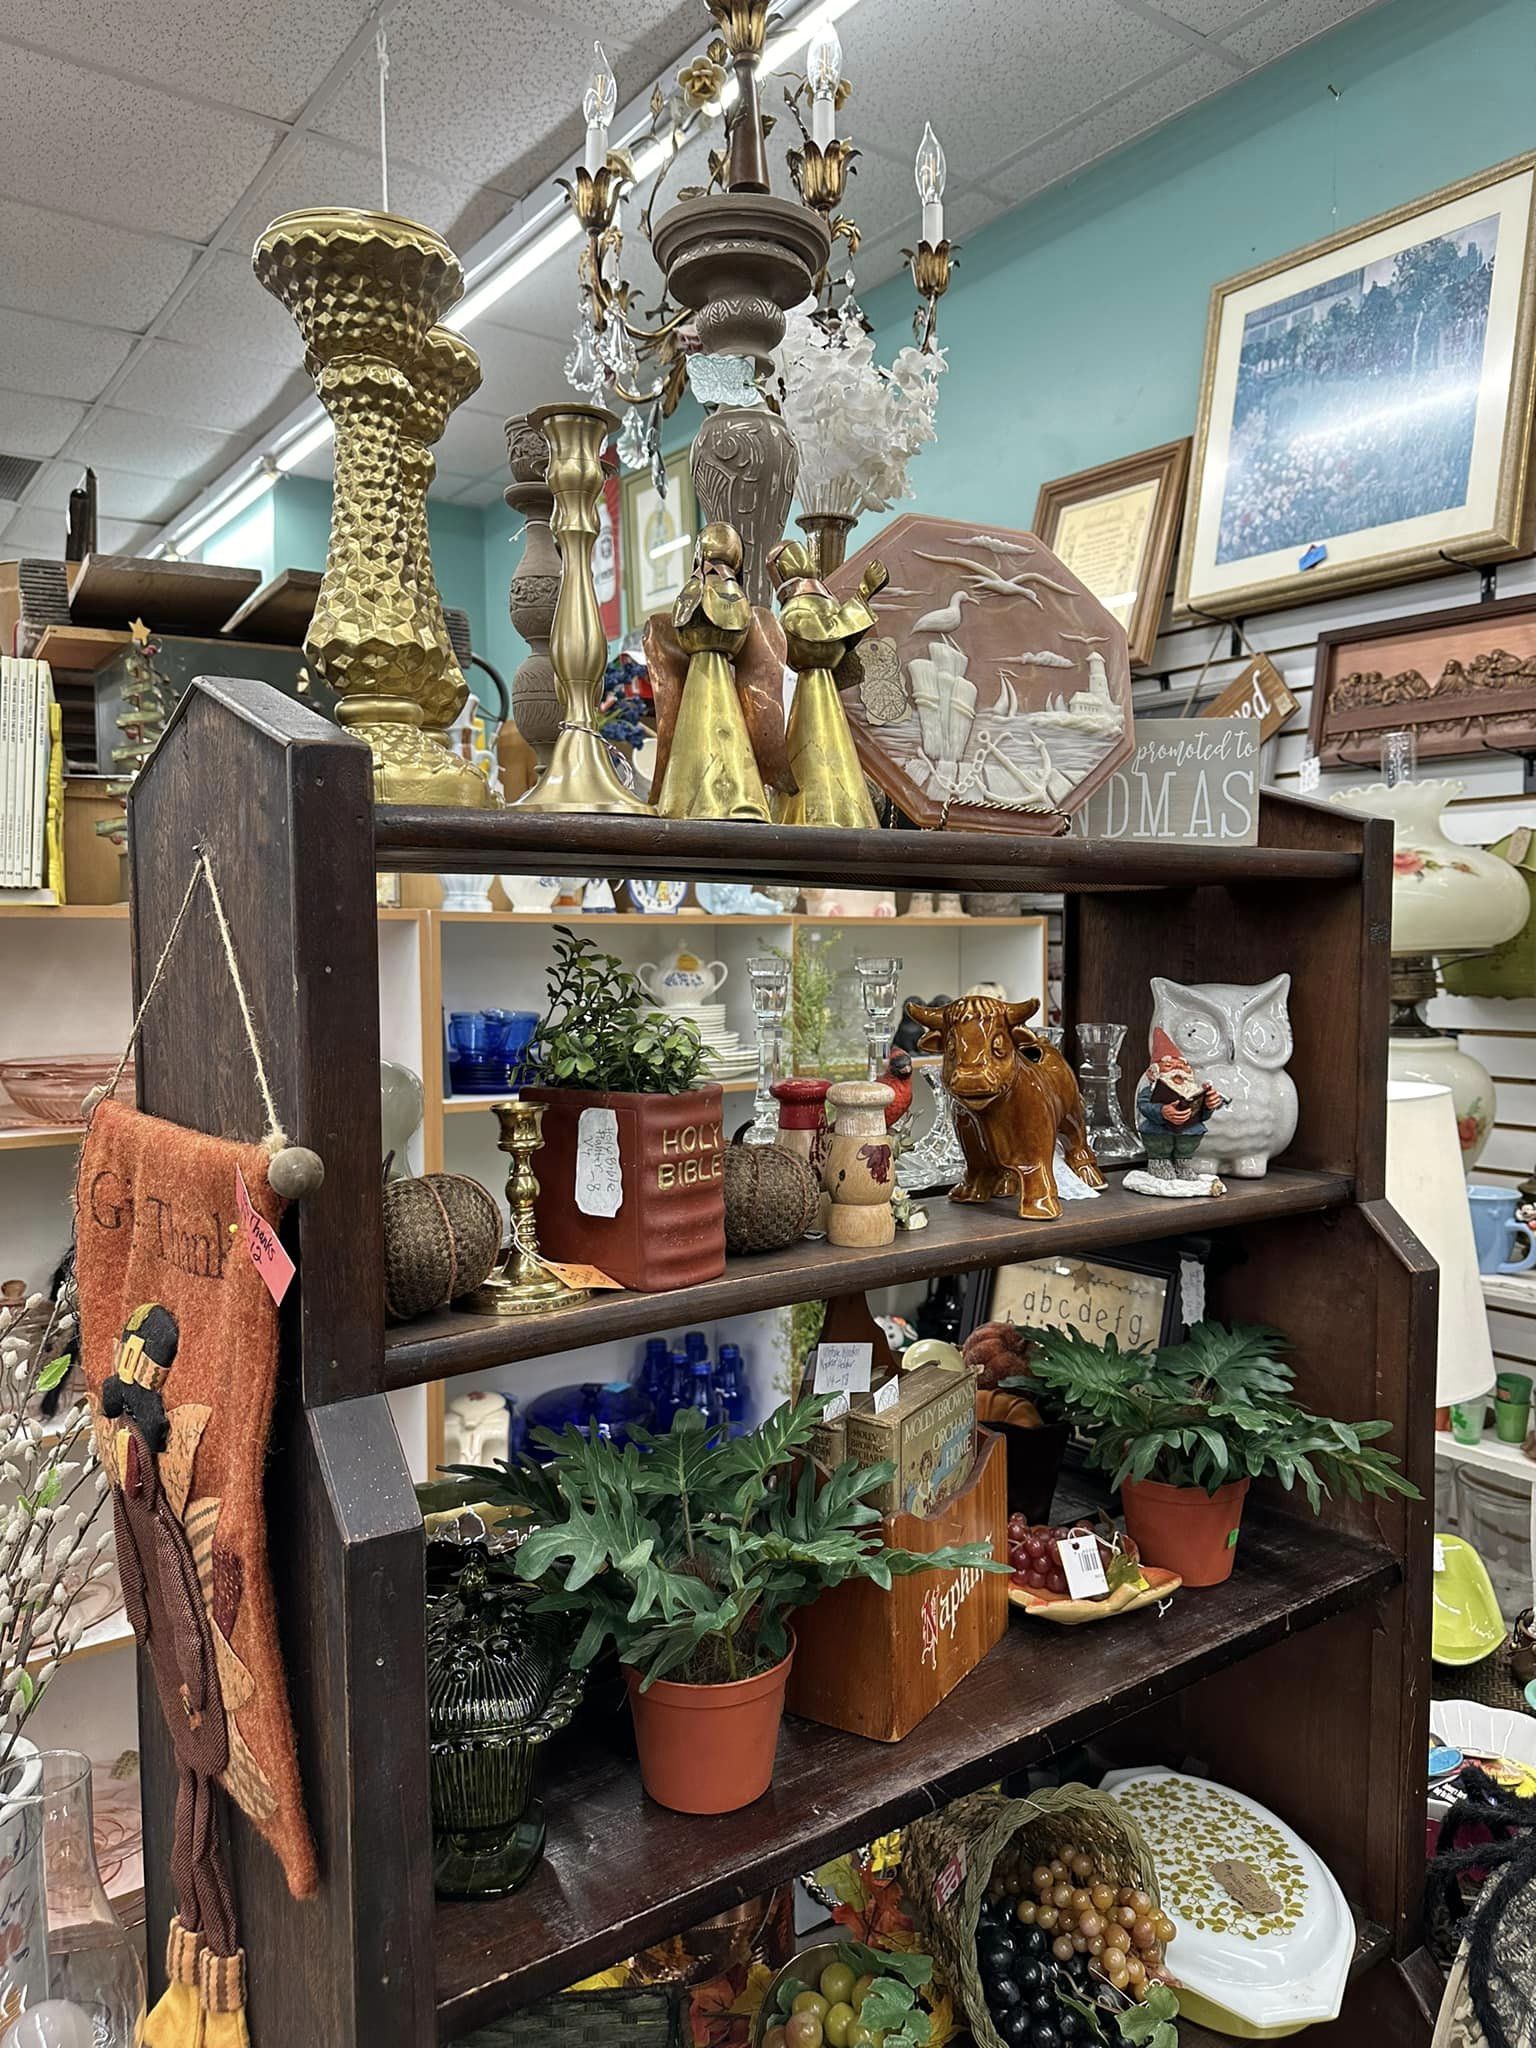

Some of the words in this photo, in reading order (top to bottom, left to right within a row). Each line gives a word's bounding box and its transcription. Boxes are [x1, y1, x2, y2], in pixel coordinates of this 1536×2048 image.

[1131, 730, 1232, 776] promoted
[1234, 729, 1258, 759] to
[662, 1122, 723, 1156] HOLY
[656, 1152, 724, 1192] BIBLE
[903, 1407, 936, 1444] MOLLY
[932, 1407, 975, 1451] ORCHARD
[944, 1432, 974, 1469] HOME
